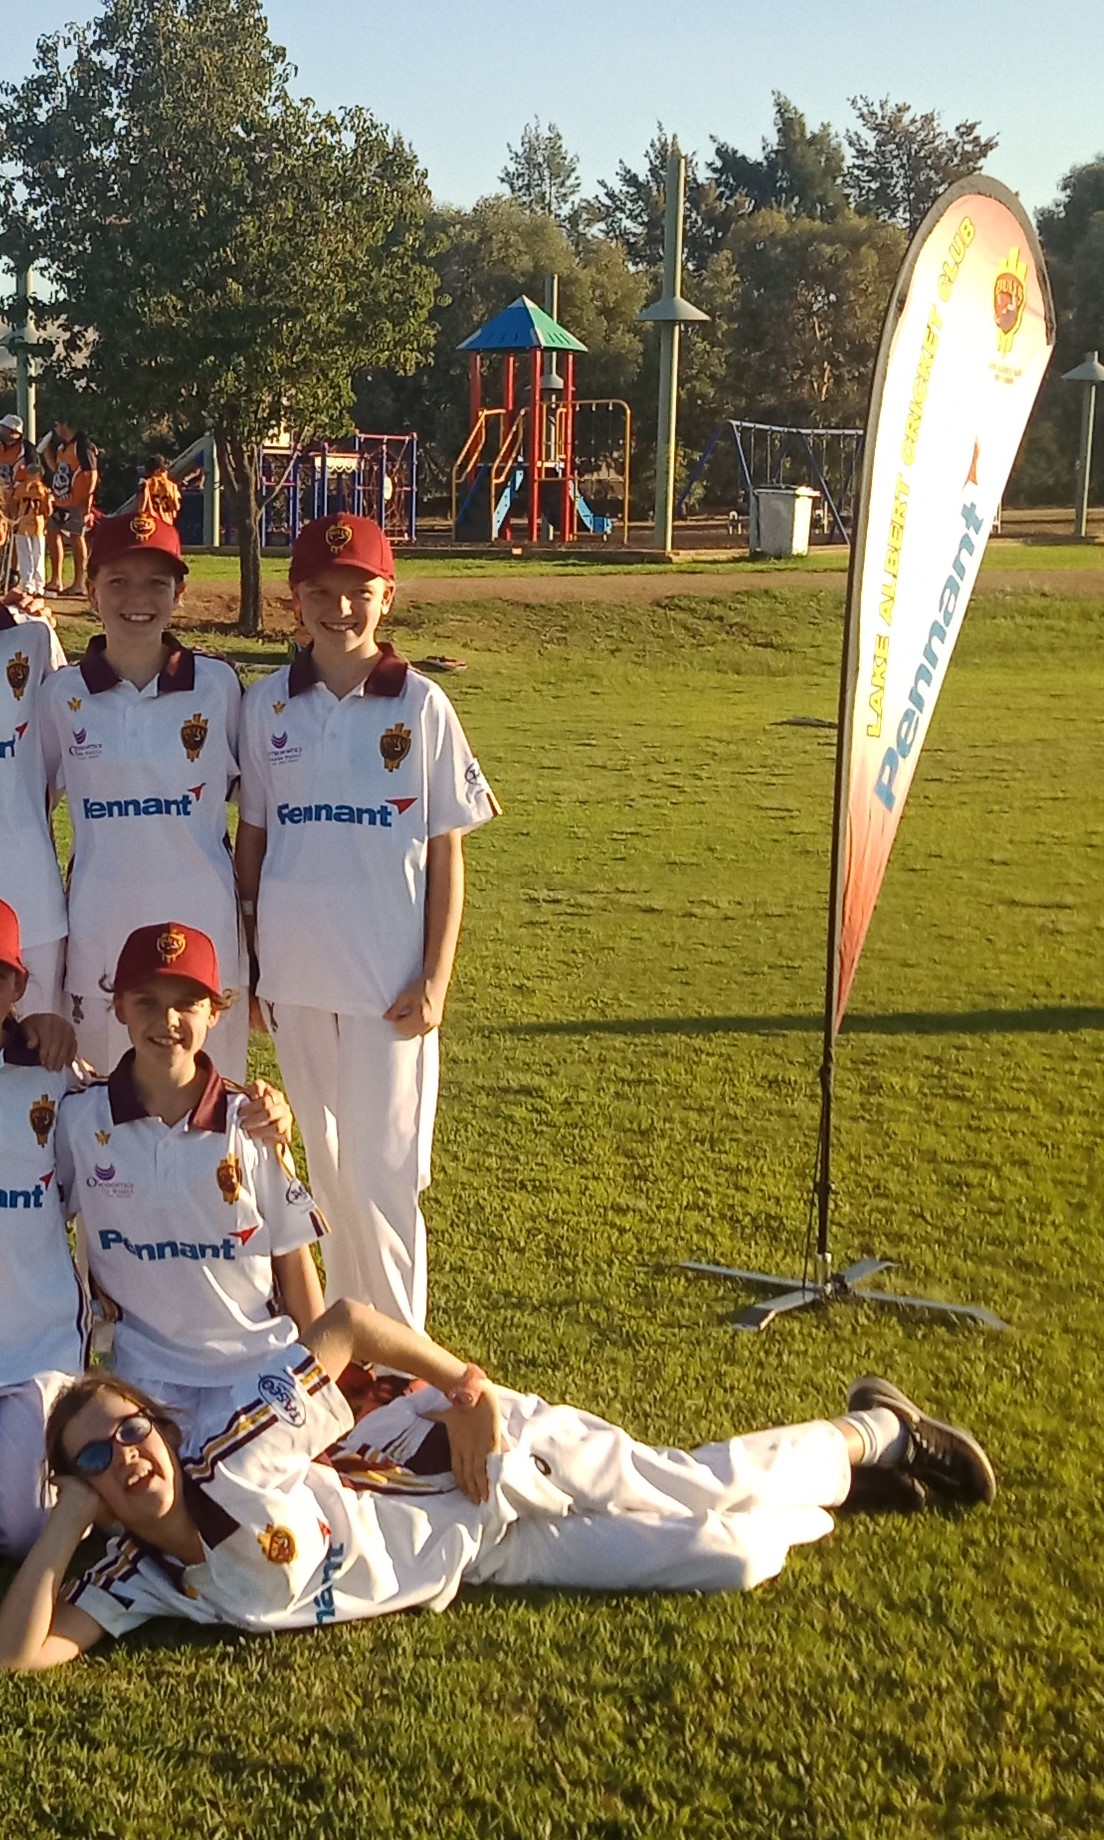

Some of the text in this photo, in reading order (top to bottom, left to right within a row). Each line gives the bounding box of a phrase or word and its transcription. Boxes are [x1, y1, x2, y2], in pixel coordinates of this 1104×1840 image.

[867, 216, 976, 738] LAKE ALBERT CRICKET CLUB
[874, 501, 985, 813] Pennant
